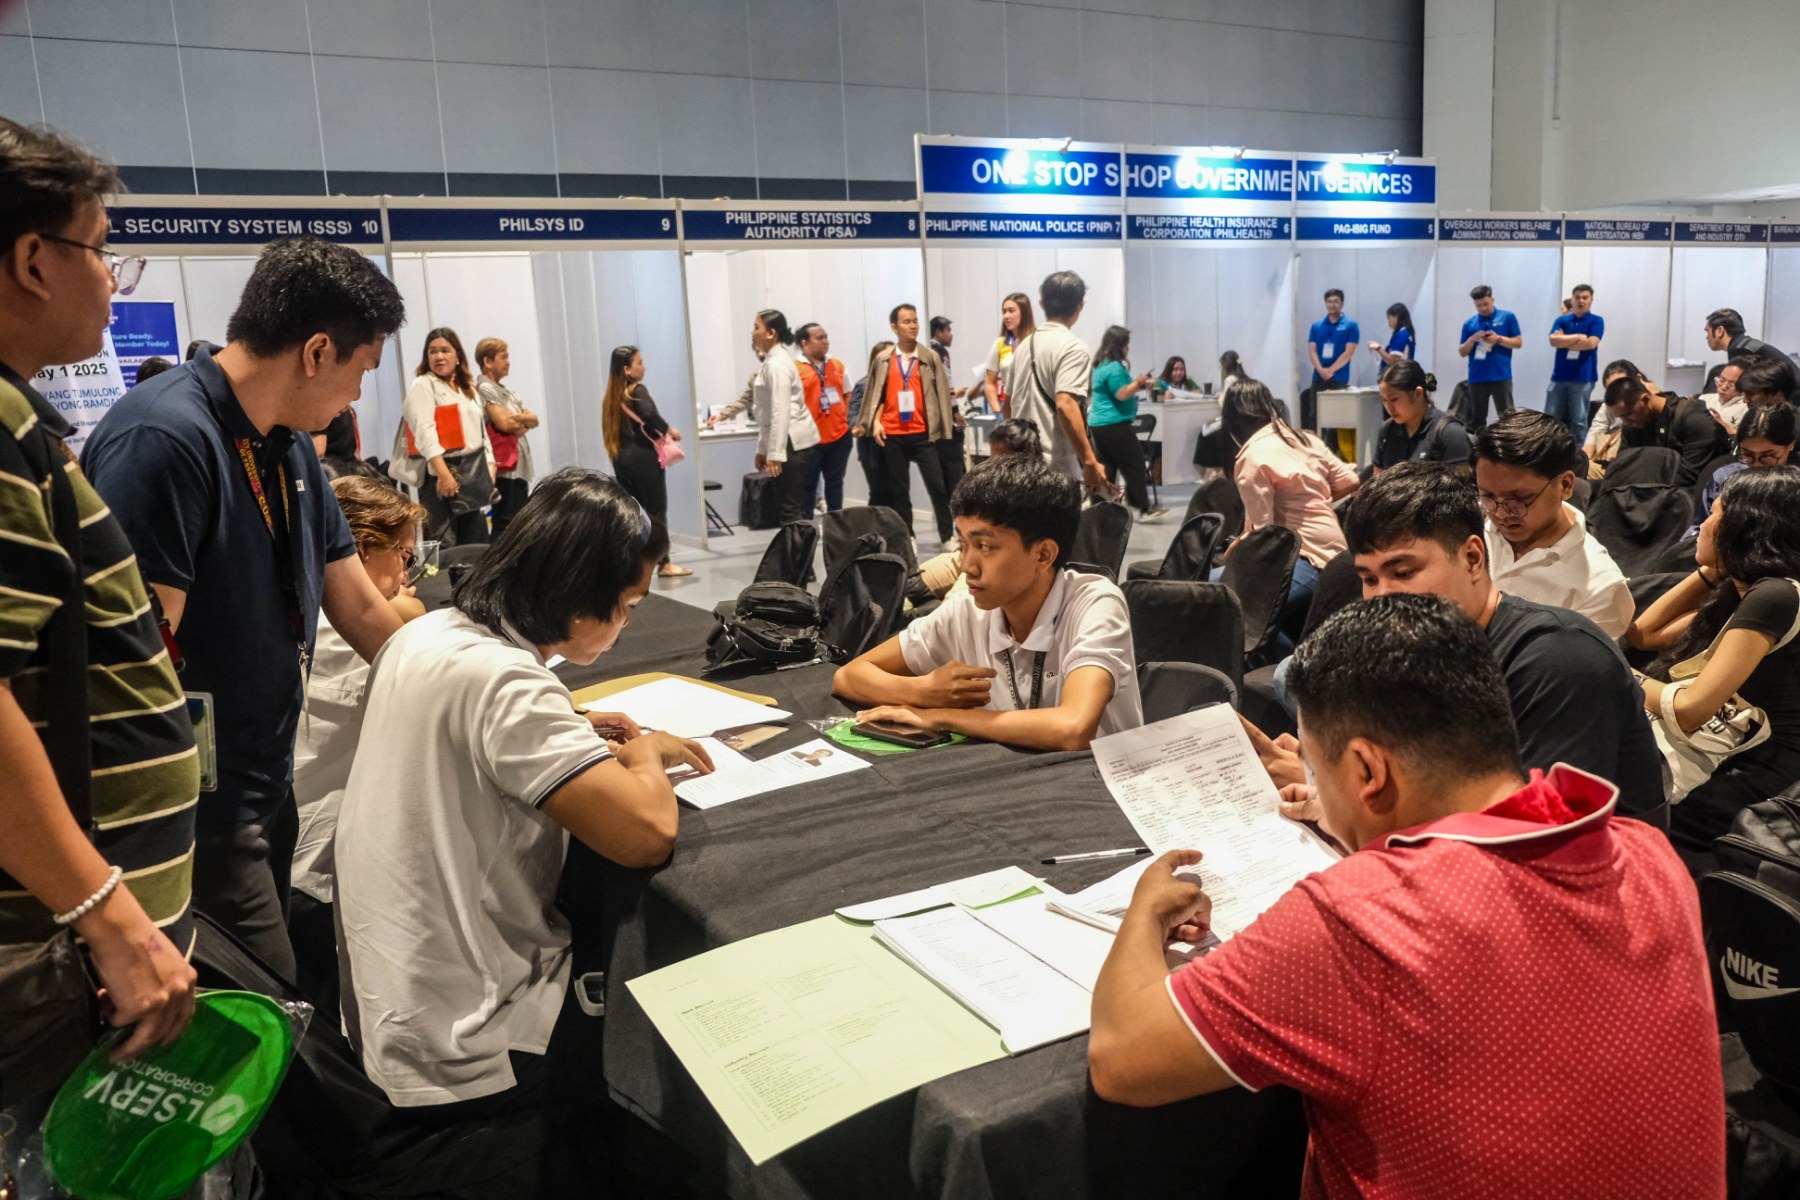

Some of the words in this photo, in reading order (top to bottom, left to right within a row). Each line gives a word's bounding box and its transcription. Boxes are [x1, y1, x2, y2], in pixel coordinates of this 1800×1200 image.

[1033, 160, 1098, 186] STOP
[1104, 163, 1170, 188] SHOP
[1175, 166, 1322, 192] GOVERNMENT
[1325, 171, 1412, 194] SERVICES
[725, 212, 799, 225] PHILIPPINE
[801, 212, 872, 225] STATISTICS
[1136, 216, 1188, 228] PHILIPPINE
[1189, 216, 1225, 228] HEALTH
[1227, 217, 1278, 228] INSURANCE
[125, 219, 222, 234] SECURITY
[228, 219, 303, 234] SYSTEM
[308, 220, 352, 235] (SSS)
[361, 220, 379, 234] 10
[499, 218, 566, 232] PHILSYS
[569, 218, 585, 232] ID
[661, 218, 671, 232] 9
[908, 218, 917, 232] 8
[926, 220, 988, 232] PHILIPPINE
[990, 220, 1044, 233] NATIONAL
[1046, 221, 1085, 233] POLICE
[1086, 221, 1113, 233] (PNP)
[1115, 222, 1122, 233] 7
[1283, 223, 1290, 234] 6
[1333, 223, 1368, 234] PAG-IBIG
[1369, 223, 1391, 234] FUND
[1428, 224, 1433, 234] 5
[1444, 220, 1483, 230] OVERSEAS
[1484, 220, 1519, 230] WORKERS
[1520, 221, 1552, 231] WELFARE
[1555, 226, 1561, 235] 4
[1584, 221, 1615, 230] NATIONAL
[1616, 222, 1640, 231] BUREAU
[1641, 222, 1650, 231] OF
[1689, 223, 1725, 232] DEPARTMENT
[1725, 224, 1733, 232] OF
[1734, 224, 1752, 233] TRADE
[744, 226, 821, 239] AUTHORITY
[823, 226, 858, 239] (PSA)
[1143, 228, 1211, 239] CORPORATION
[1213, 228, 1273, 239] (PHILHEALTH)
[1452, 230, 1511, 240] ADMINISTRATION
[1586, 230, 1631, 239] INVESTIGATION
[1695, 232, 1707, 240] AND
[35, 368, 54, 380] ay
[60, 366, 68, 377] 1
[72, 363, 108, 377] 2025
[42, 389, 71, 400] YANG
[72, 387, 121, 398] TUMULONG
[54, 400, 83, 410] YONG
[83, 398, 118, 409] RAMDA
[1726, 946, 1779, 989] NIKE
